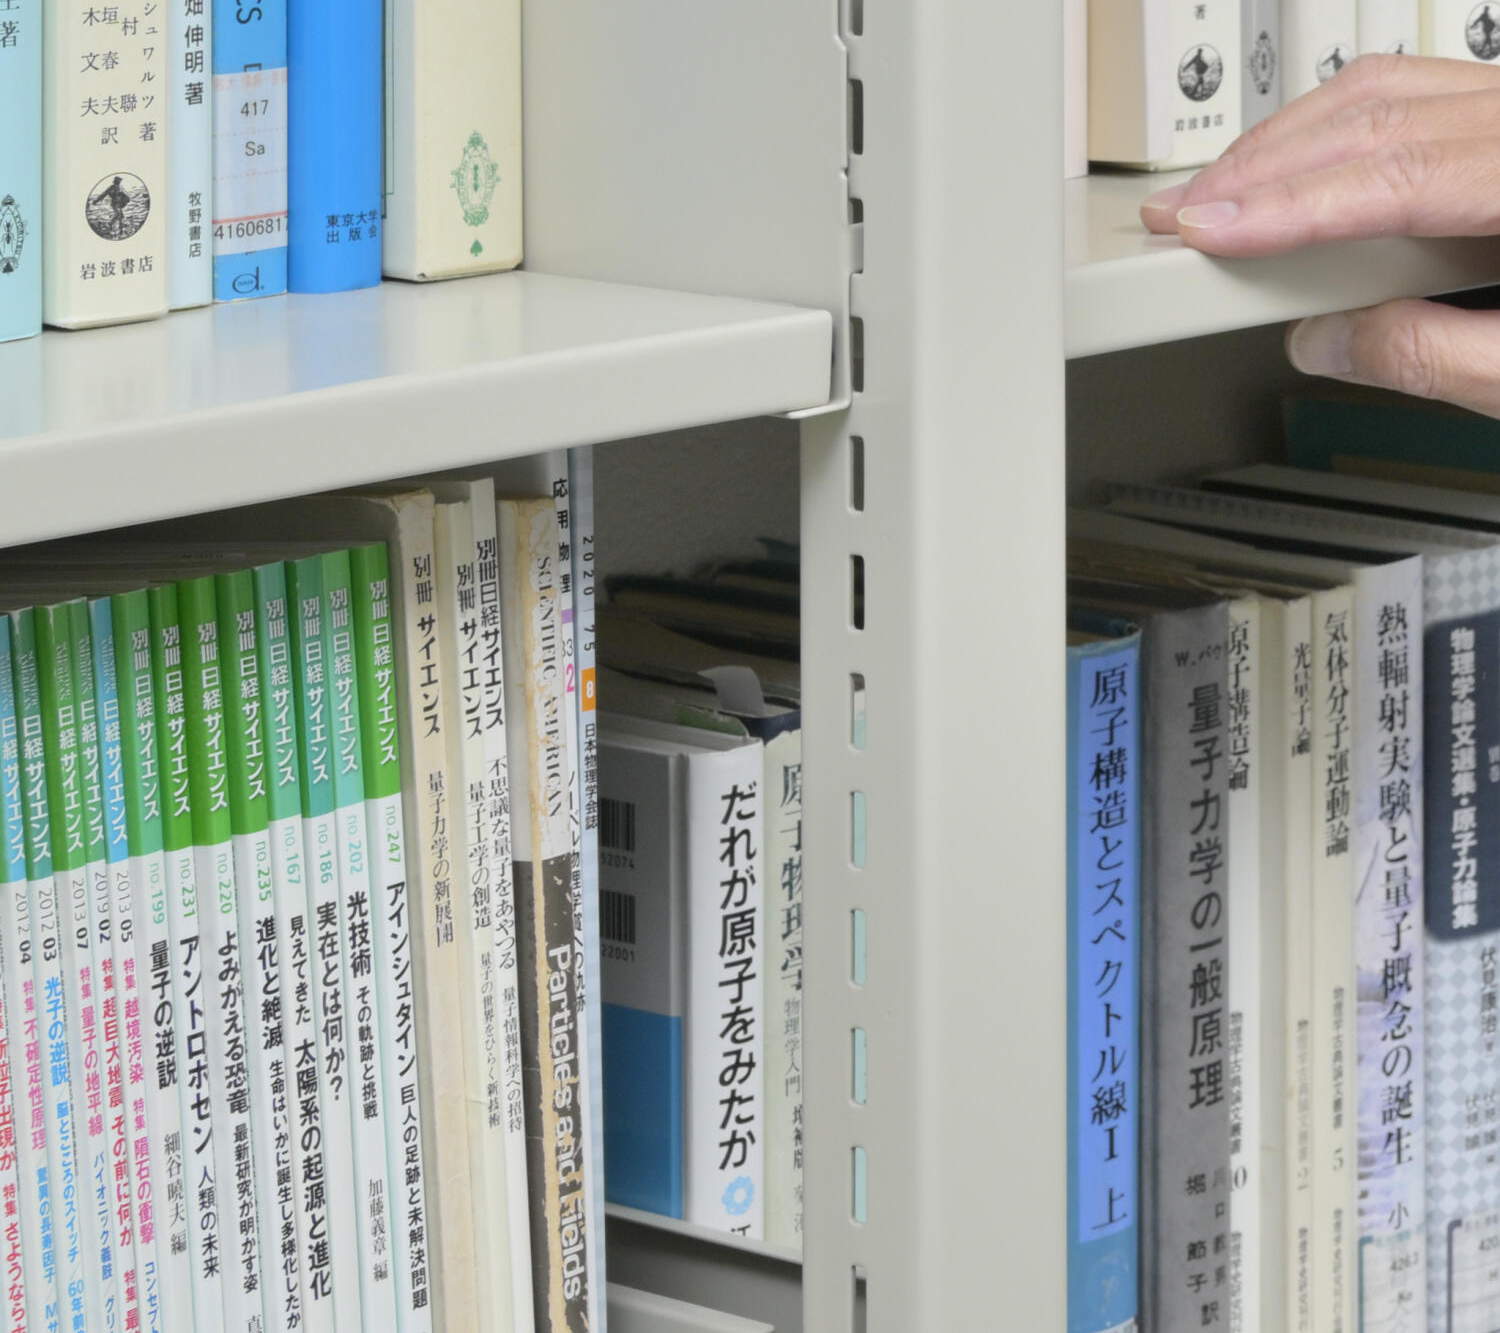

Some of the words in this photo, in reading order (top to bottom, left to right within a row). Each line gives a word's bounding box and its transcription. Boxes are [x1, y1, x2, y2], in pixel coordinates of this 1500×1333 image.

[239, 99, 269, 118] 417
[244, 139, 266, 158] Sa
[79, 254, 155, 282] 岩波書店
[370, 579, 397, 766] 別冊日経サイエンス
[416, 612, 440, 739] サイエンス
[1325, 610, 1349, 858] 気体分子運動論
[347, 814, 363, 874] no.202
[386, 805, 401, 864] no.247
[427, 771, 454, 948] 量子力学の新展開
[1187, 682, 1224, 1110] 量子力学の一般原理
[1376, 601, 1413, 1166] 熱輻射実験と量子概念の誕生
[150, 939, 177, 1090] 量子の逆説
[256, 915, 284, 1050] 進化と絶滅
[316, 900, 345, 1102] 実在とは何か？
[347, 890, 371, 979] 光技術
[386, 880, 416, 1078] アインシュタイン
[716, 780, 759, 1172] だれが原子をみたか
[295, 1038, 331, 1301] 太陽系の起源と進化
[400, 1083, 428, 1310] 巨人の足跡と未解決問題
